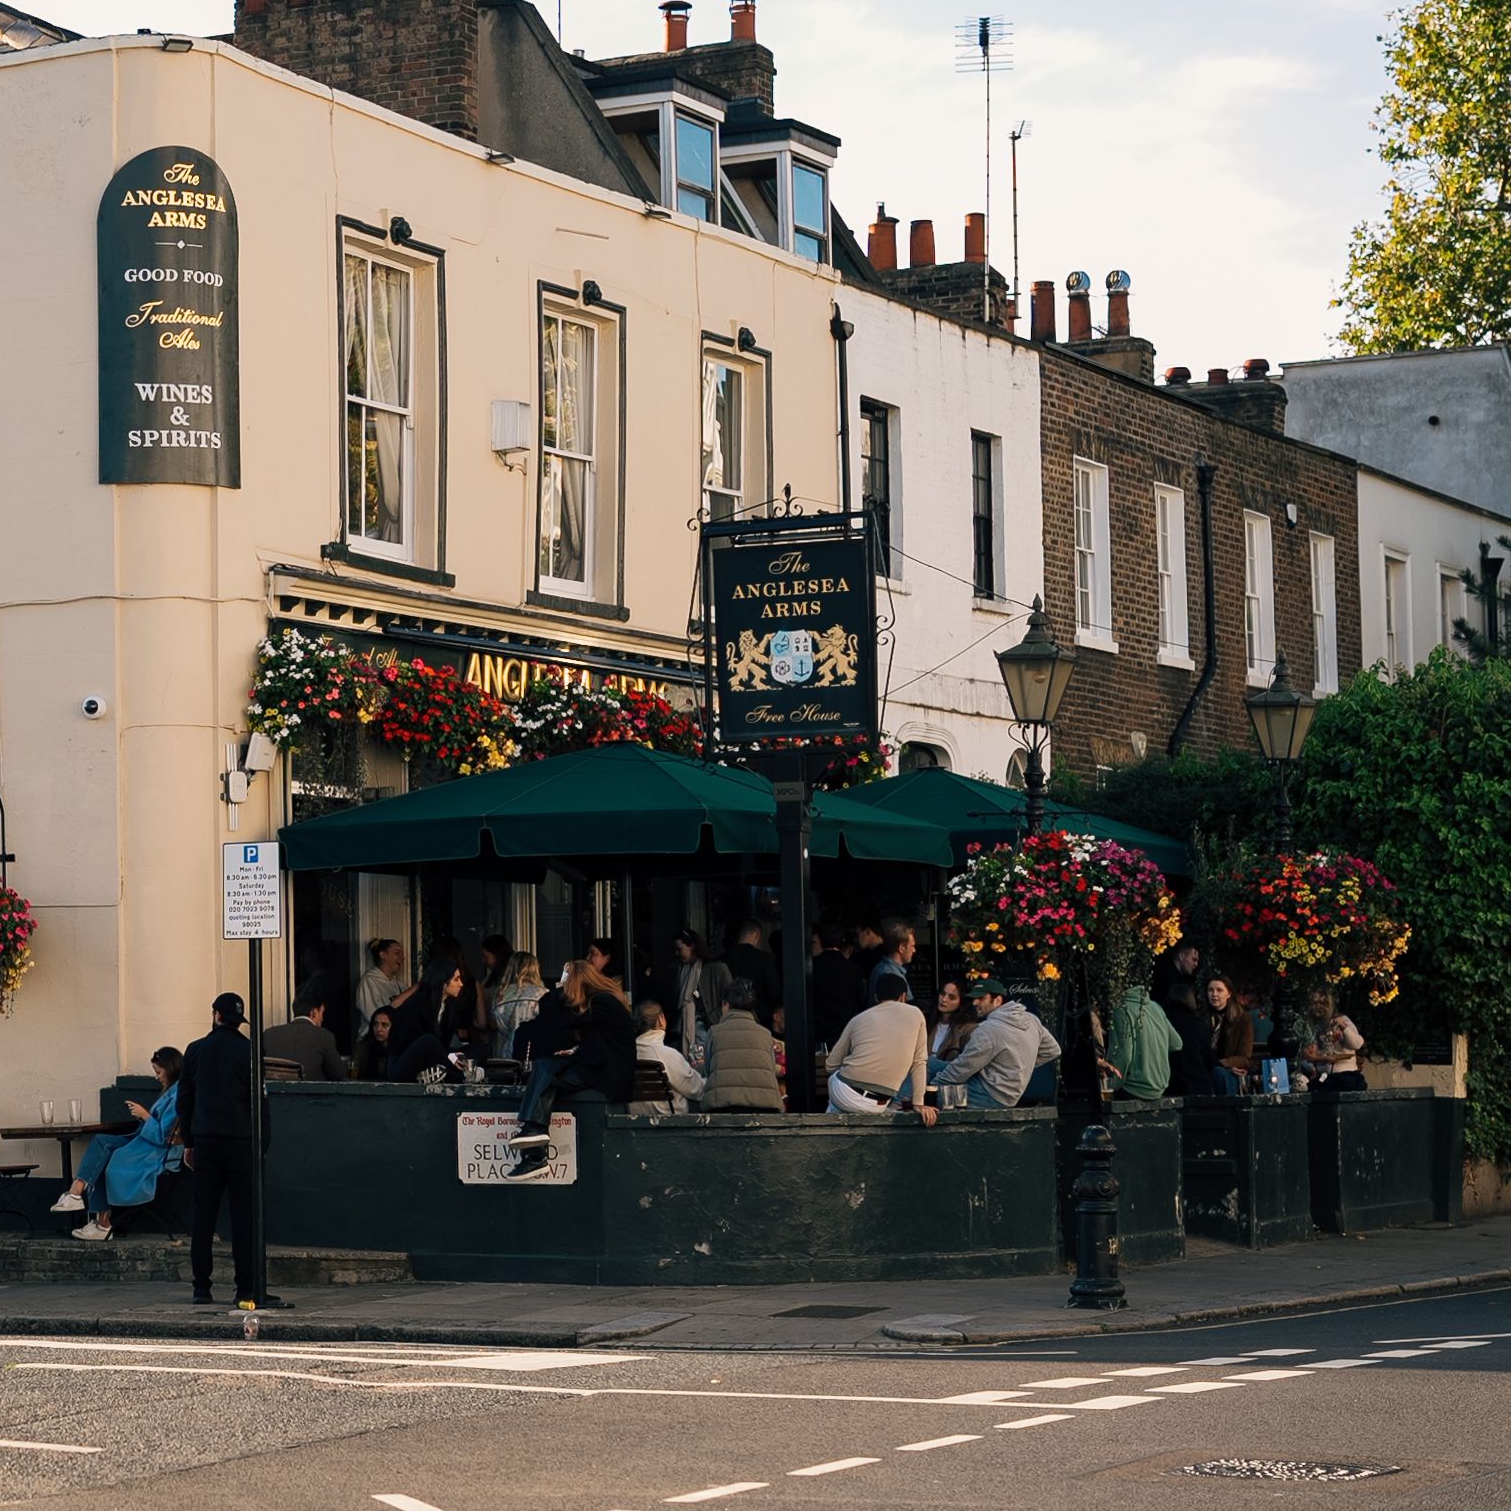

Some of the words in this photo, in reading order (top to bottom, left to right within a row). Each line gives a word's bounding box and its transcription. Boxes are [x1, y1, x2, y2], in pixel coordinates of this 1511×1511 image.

[164, 163, 200, 186] The
[121, 190, 227, 214] ANGLESEA
[147, 211, 207, 230] ARMS
[124, 268, 178, 283] GOOD
[182, 269, 224, 288] FOOD
[125, 300, 223, 329] Traditional
[159, 328, 201, 350] Ales
[135, 383, 213, 405] WINES
[170, 406, 190, 426] &
[128, 430, 222, 450] SPIRITS
[768, 551, 811, 575] The
[732, 577, 851, 600] ANGLESEA
[761, 601, 822, 619] ARMS
[745, 704, 785, 724] Free
[790, 703, 842, 723] House
[247, 847, 257, 862] P
[462, 1117, 474, 1126] The
[476, 1117, 495, 1129] Royal
[496, 1131, 508, 1140] and
[474, 1144, 558, 1161] SELWD
[467, 1163, 510, 1180] PLAC
